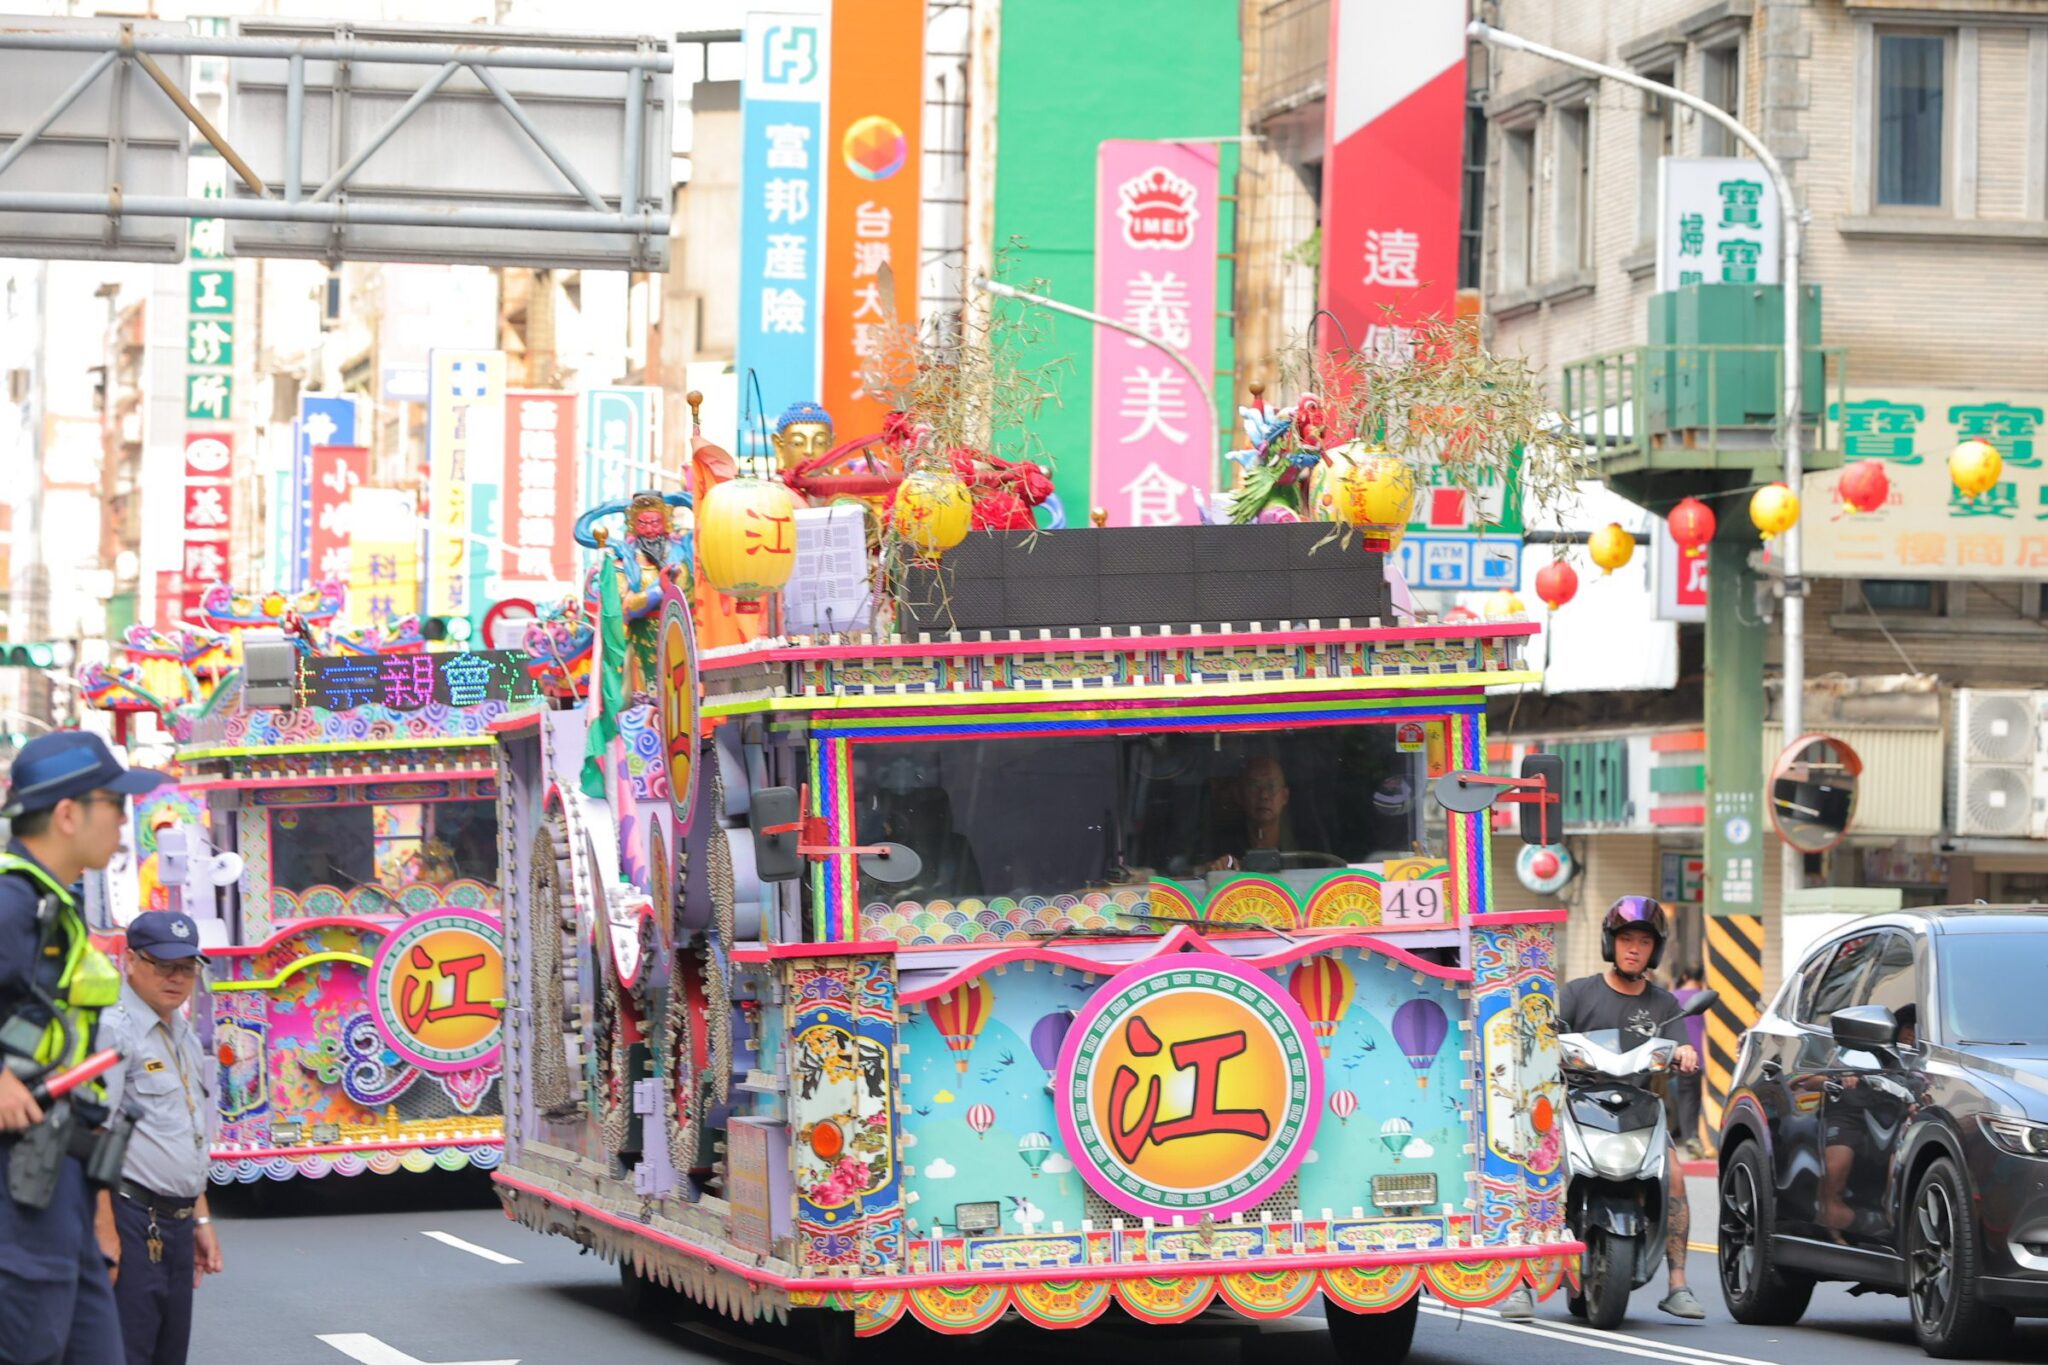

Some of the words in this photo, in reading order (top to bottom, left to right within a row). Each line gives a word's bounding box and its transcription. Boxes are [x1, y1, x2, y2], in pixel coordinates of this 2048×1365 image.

[760, 123, 812, 335] 富邦產險
[1134, 217, 1184, 235] IMEI
[1718, 178, 1763, 284] 寶寶
[1119, 270, 1191, 527] 義美食
[1828, 399, 2044, 468] 寶寶
[745, 508, 792, 556] 江
[1431, 547, 1463, 558] ATM
[1834, 530, 2048, 568] 二樓商店
[1386, 886, 1438, 919] 49
[401, 945, 499, 1035] 江
[1108, 1015, 1270, 1165] 江
